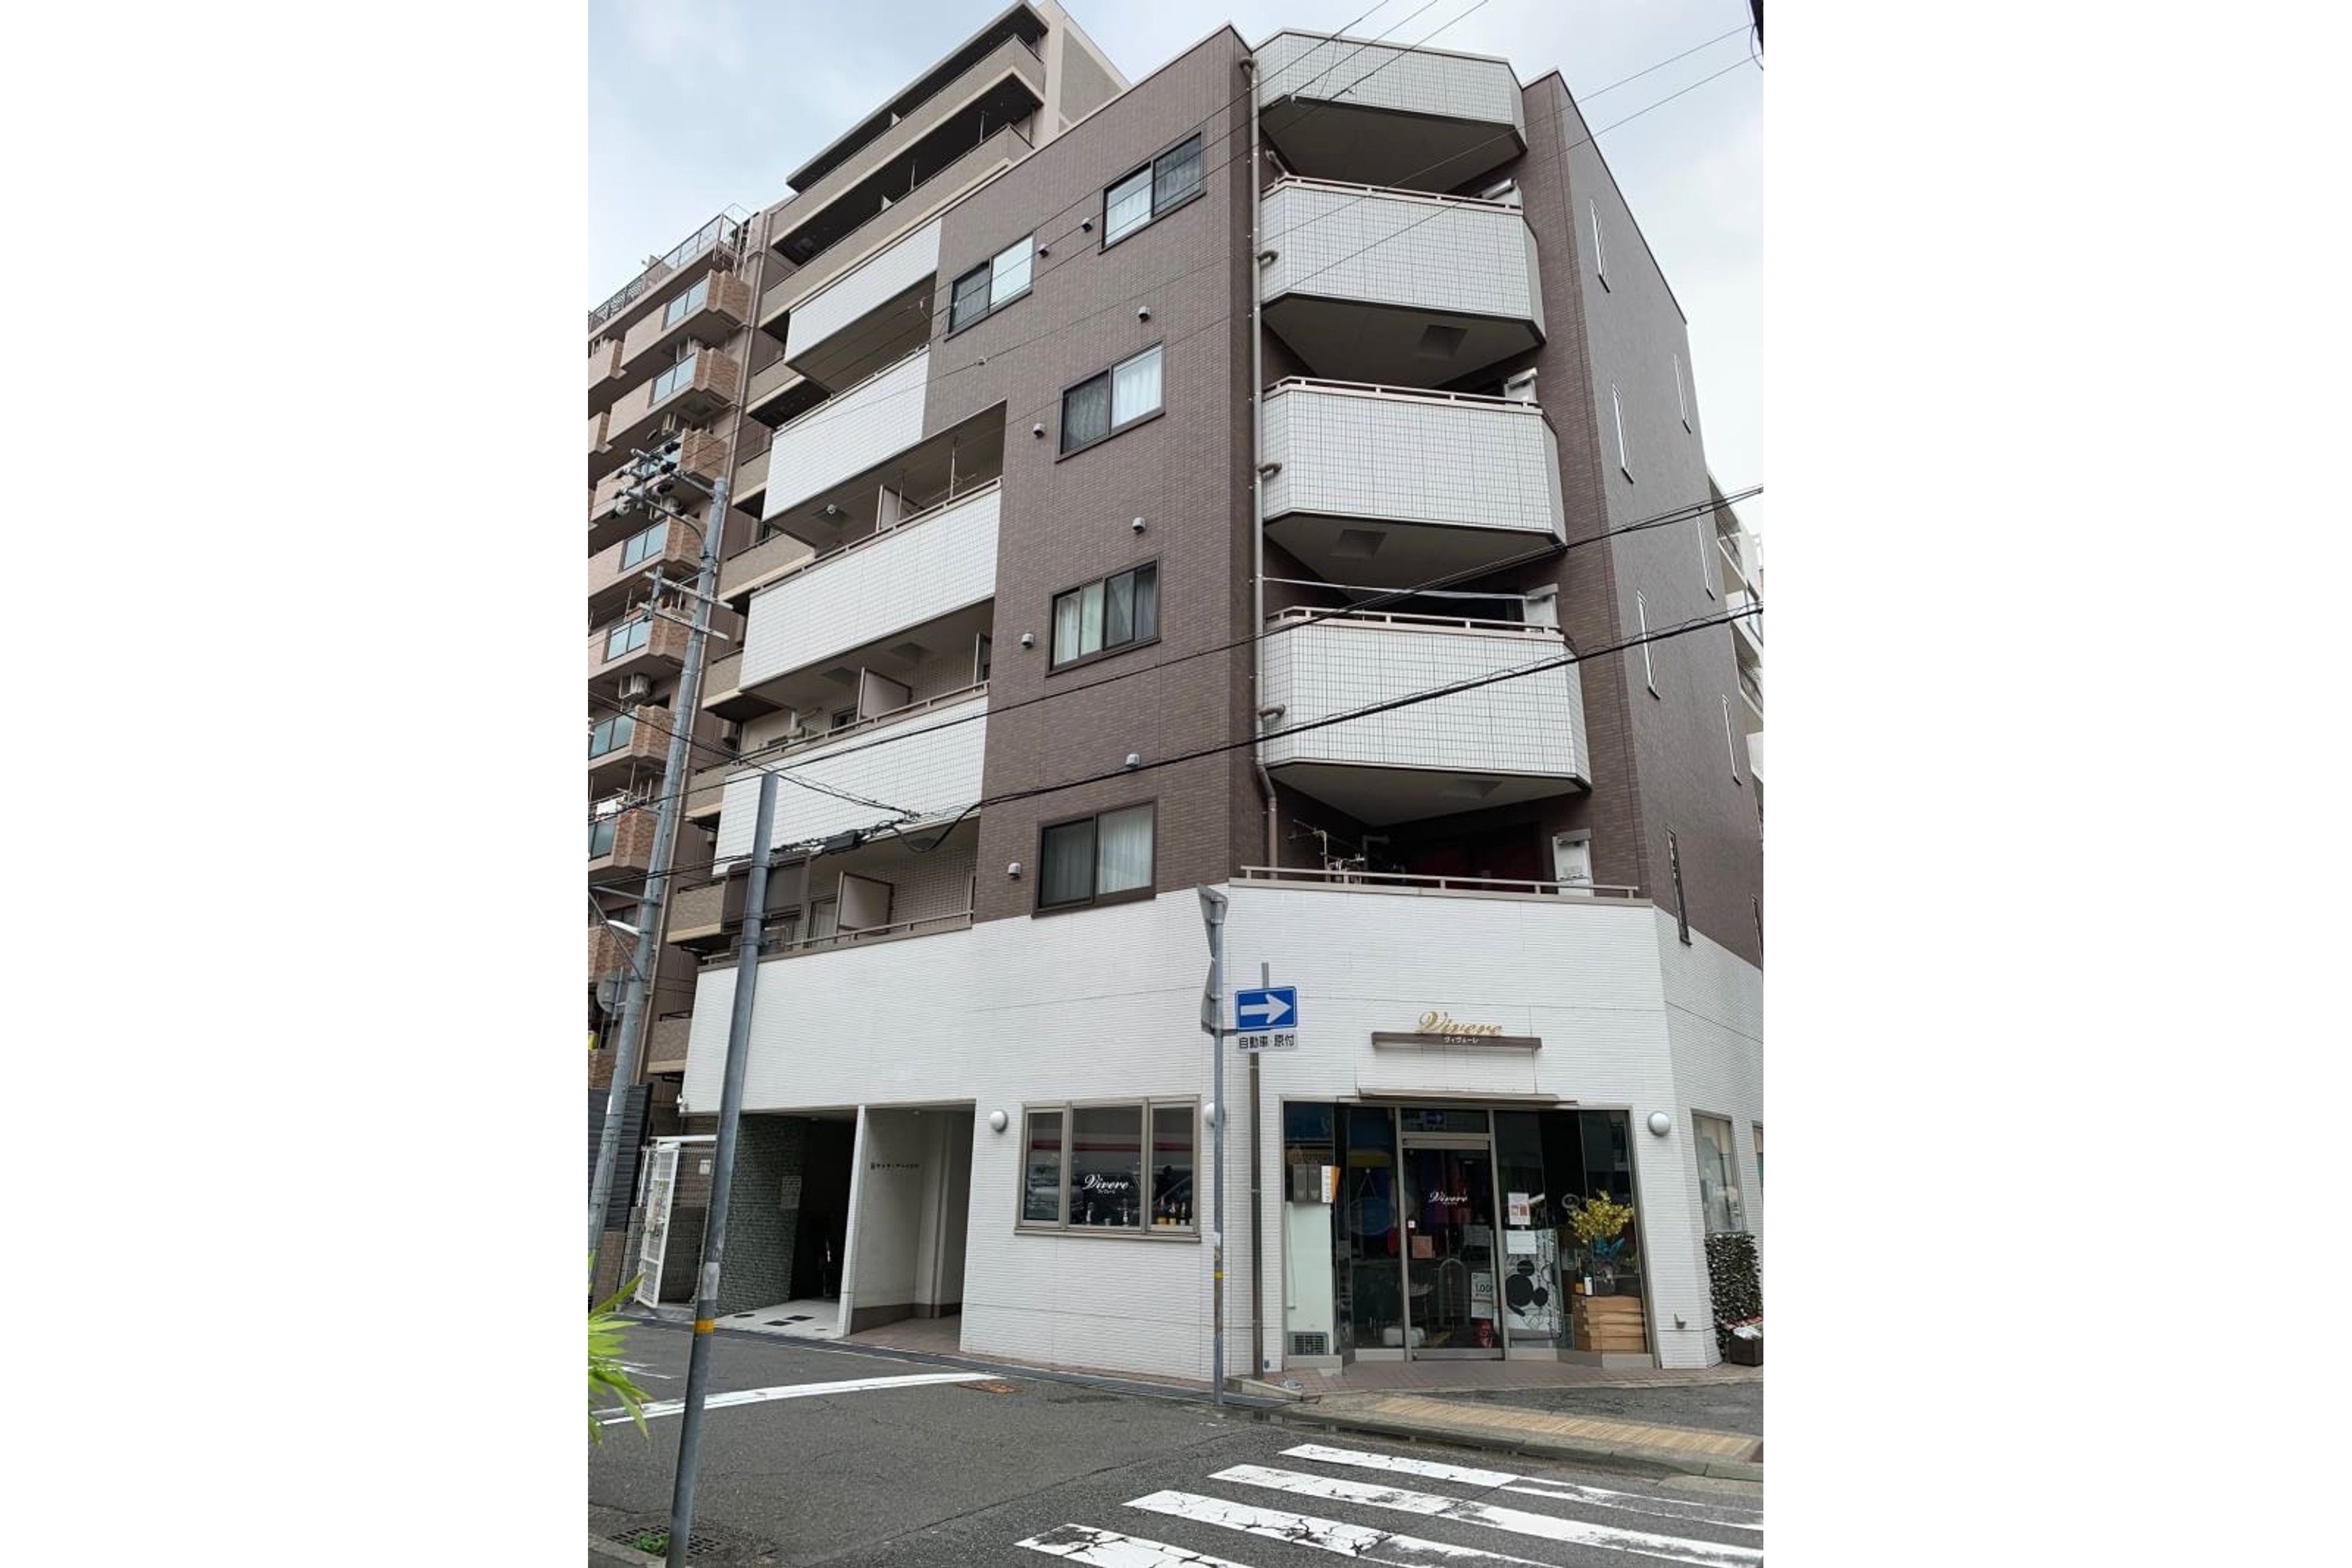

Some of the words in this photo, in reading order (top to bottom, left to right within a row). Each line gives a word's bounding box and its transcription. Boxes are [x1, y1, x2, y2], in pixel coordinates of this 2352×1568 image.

[1415, 1011, 1502, 1035] Vivere
[1239, 1034, 1294, 1049] 自動車・原付
[1082, 1174, 1128, 1189] Vivere
